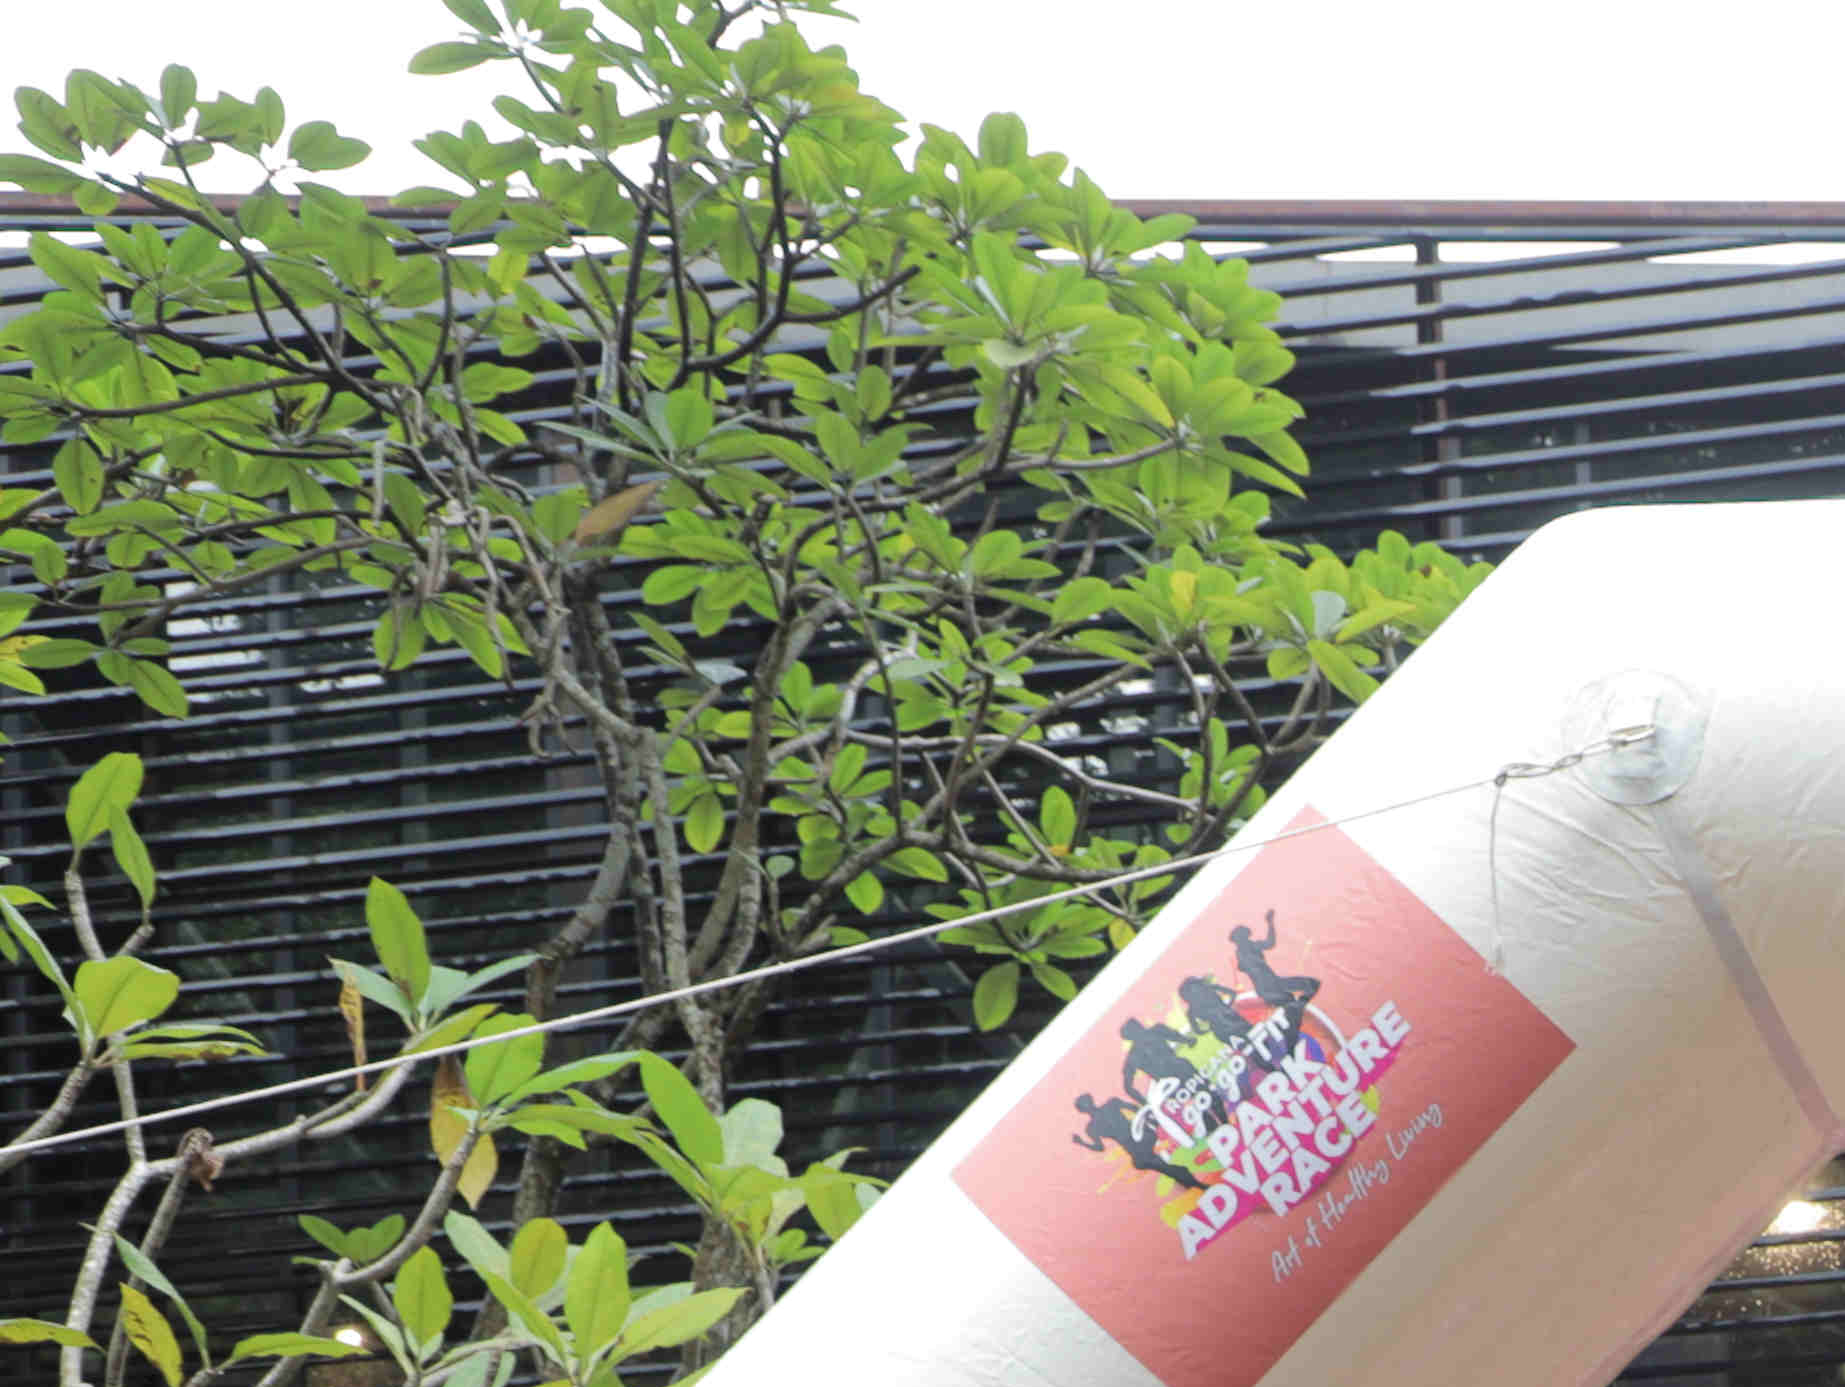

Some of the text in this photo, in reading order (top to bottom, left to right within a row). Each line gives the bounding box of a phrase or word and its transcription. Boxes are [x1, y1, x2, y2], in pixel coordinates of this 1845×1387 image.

[1177, 999, 1412, 1260] ADVENTURE
[1207, 1035, 1330, 1169] PARK
[1261, 1090, 1379, 1216] RACE
[1270, 1101, 1444, 1282] Art of Healthy Living
